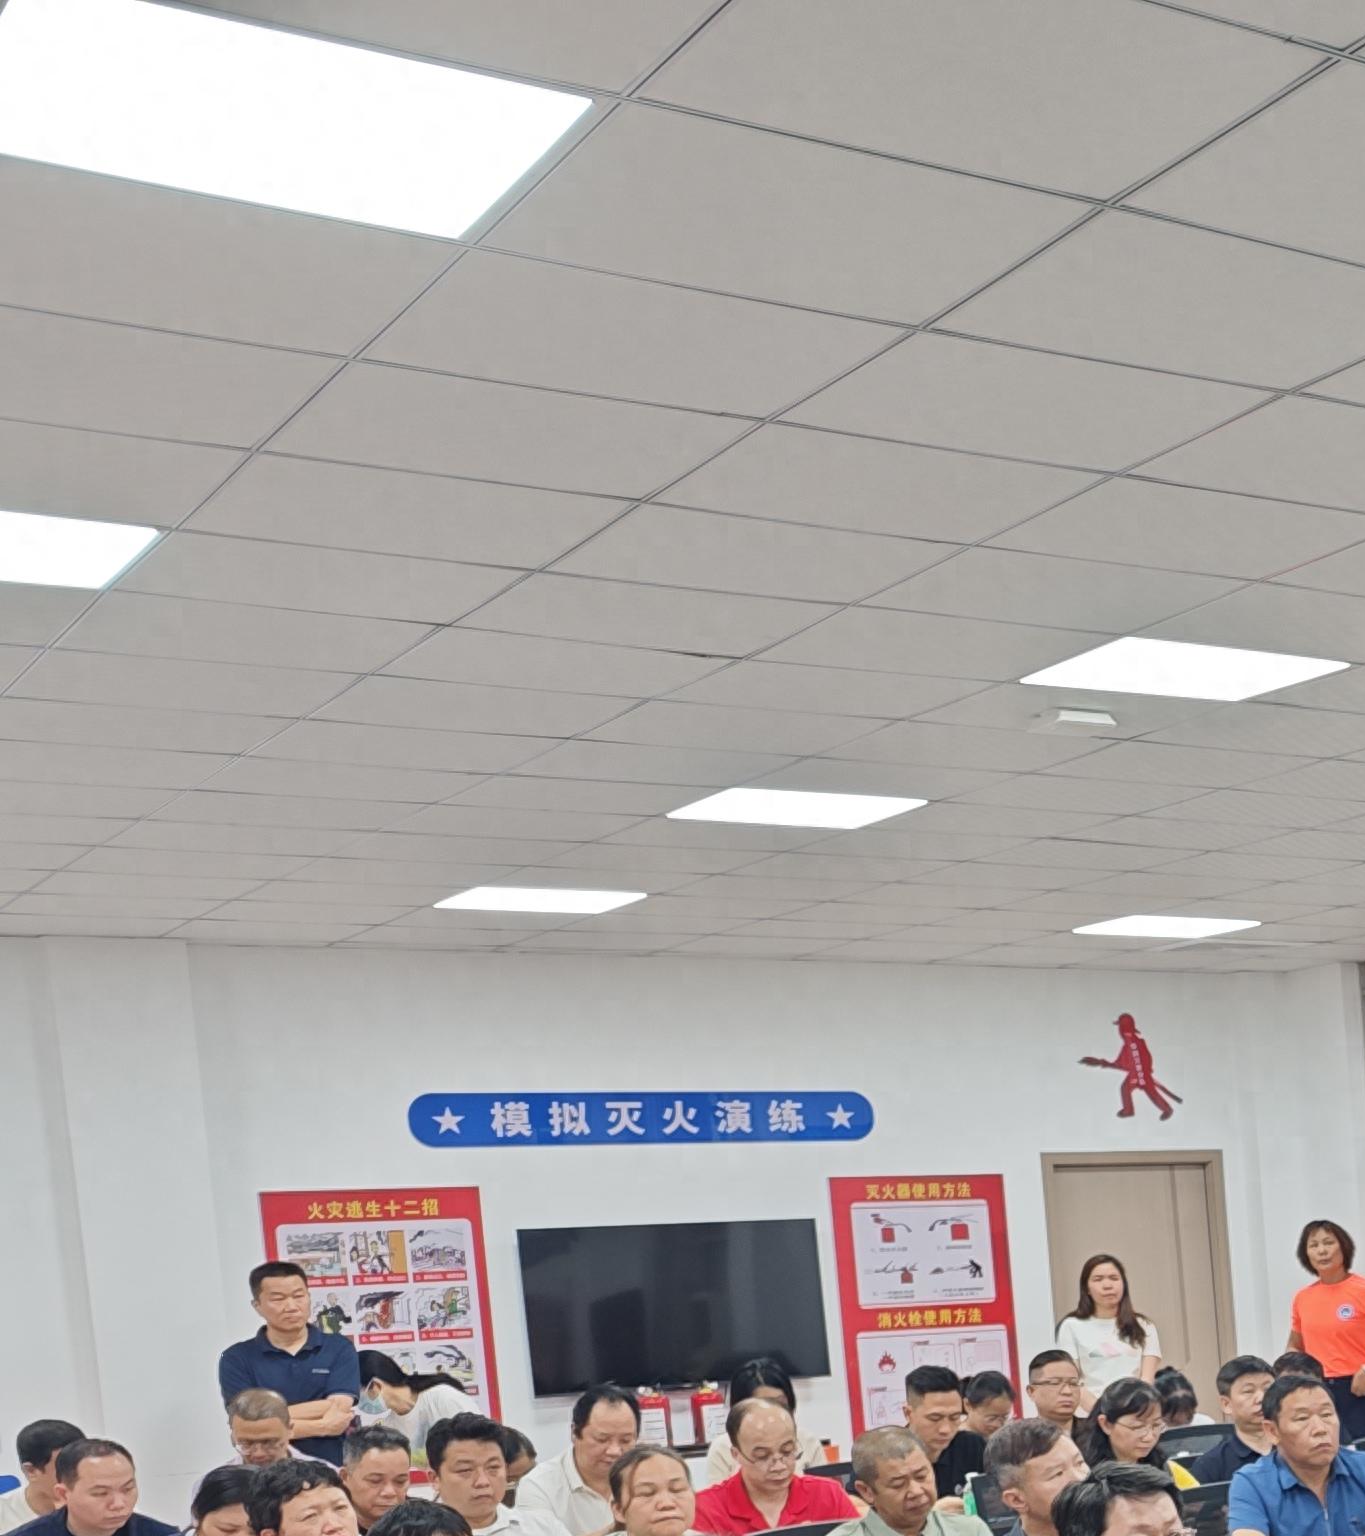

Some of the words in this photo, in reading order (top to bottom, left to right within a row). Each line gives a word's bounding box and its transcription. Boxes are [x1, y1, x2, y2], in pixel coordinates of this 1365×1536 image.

[490, 1098, 807, 1138] 模拟灭火演练
[865, 1182, 972, 1200] 灭火器使用方法
[307, 1198, 440, 1220] 火灾逃生十二招
[877, 1308, 983, 1329] 消火栓使用方法
